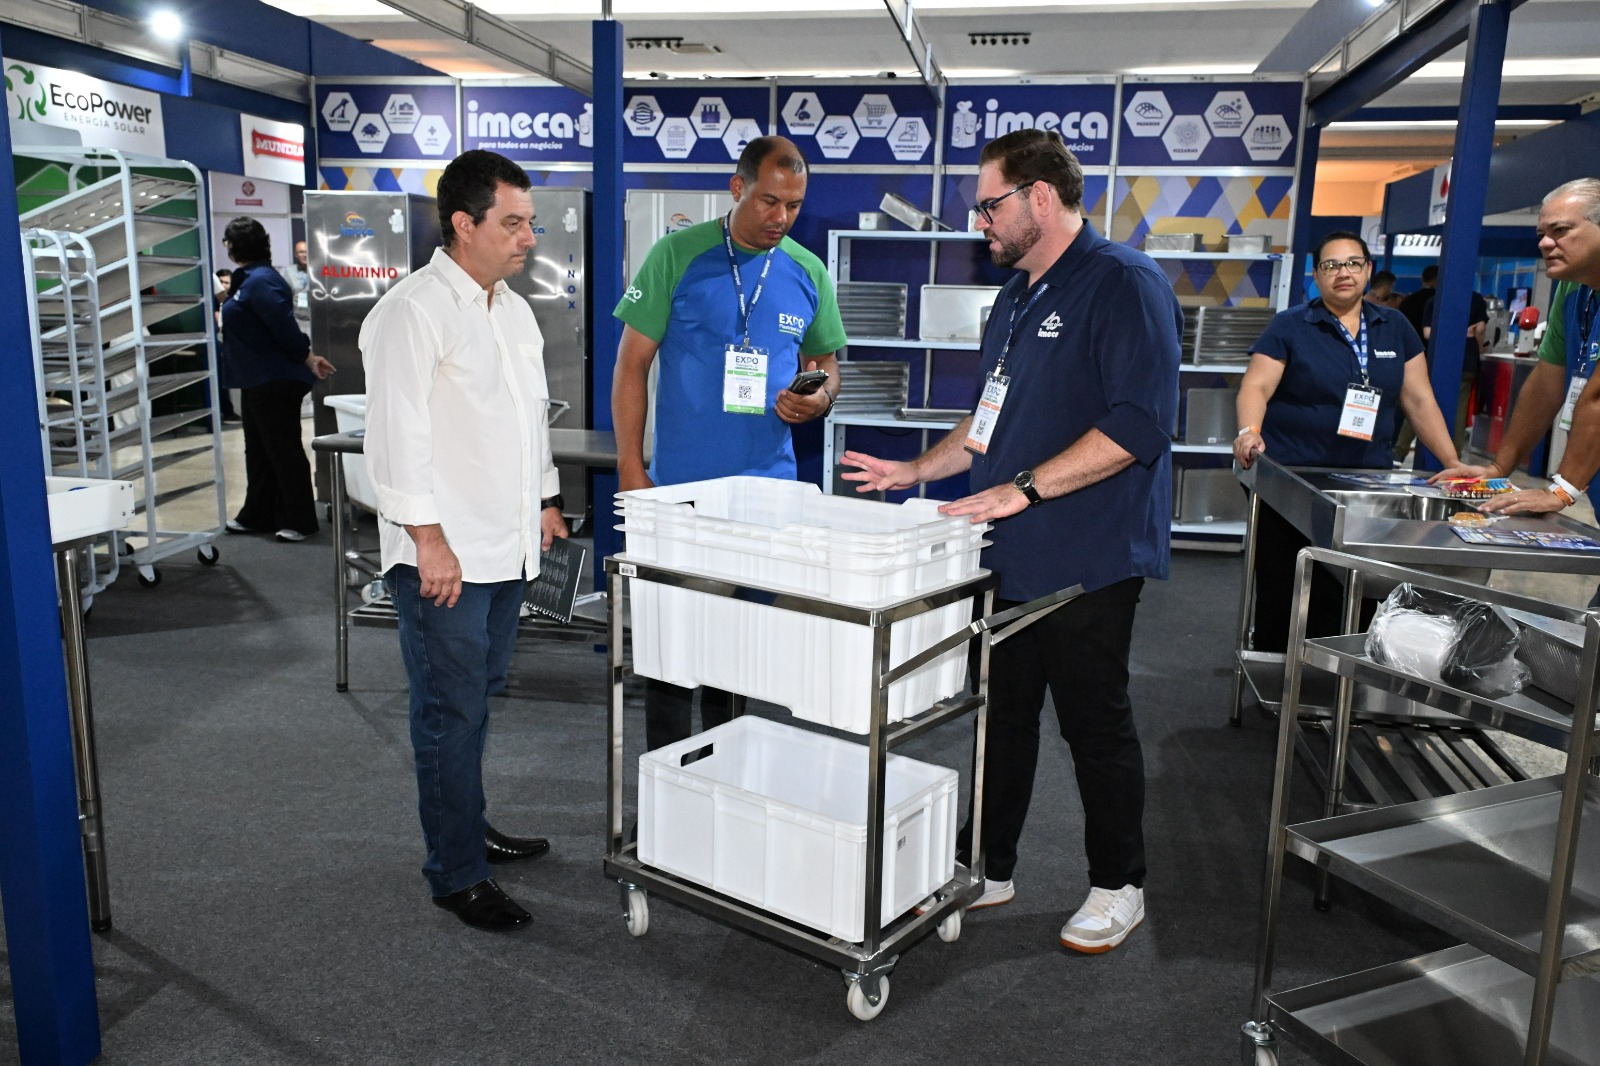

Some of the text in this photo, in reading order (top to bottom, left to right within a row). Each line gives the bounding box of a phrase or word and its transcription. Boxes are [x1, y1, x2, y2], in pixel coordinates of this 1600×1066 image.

[50, 83, 152, 124] EcoPower
[467, 100, 573, 139] imeca
[984, 98, 1108, 139] imeca
[114, 121, 145, 135] SOLAR
[478, 142, 496, 150] para
[497, 141, 519, 149] todos
[529, 141, 563, 151] negócios
[321, 265, 398, 279] ALUMINIO
[779, 313, 804, 329] EXPO
[735, 355, 759, 365] EXPO
